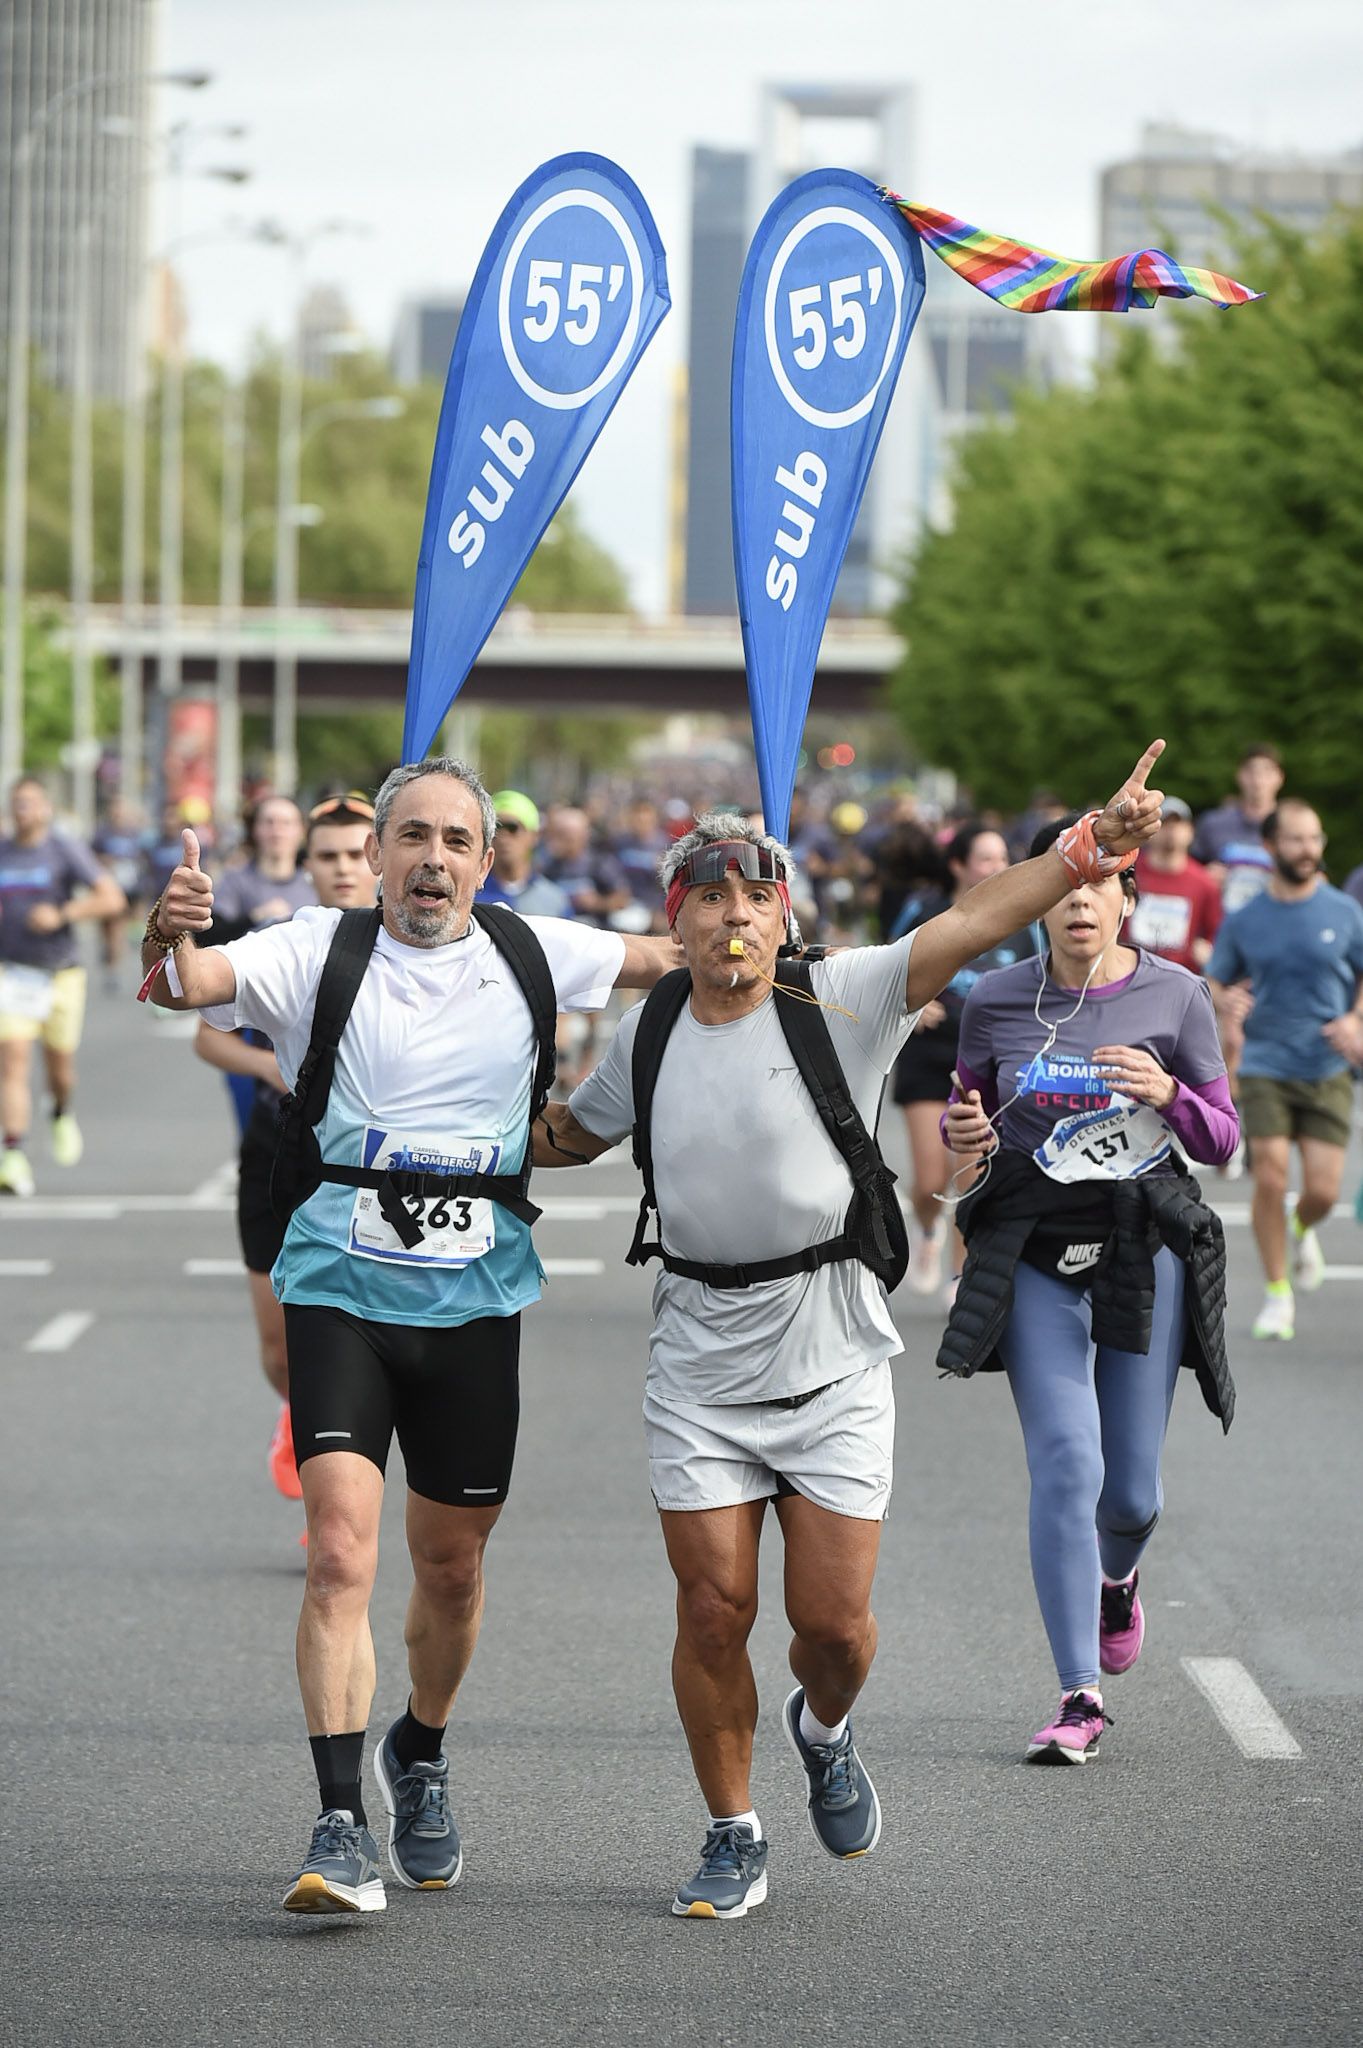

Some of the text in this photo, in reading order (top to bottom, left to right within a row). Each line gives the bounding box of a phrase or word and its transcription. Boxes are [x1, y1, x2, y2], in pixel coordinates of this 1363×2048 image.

[523, 259, 625, 346] 55'
[788, 266, 883, 370] 55'
[448, 419, 535, 569] sub
[765, 451, 828, 612] sub
[1049, 1054, 1085, 1064] CARRERA
[1035, 1091, 1111, 1109] DECIM
[1085, 1079, 1099, 1094] de
[1069, 1115, 1125, 1149] DECIMAS
[1081, 1130, 1130, 1166] 137
[411, 1153, 478, 1170] BOMBEROS
[1064, 1242, 1103, 1263] NIKE
